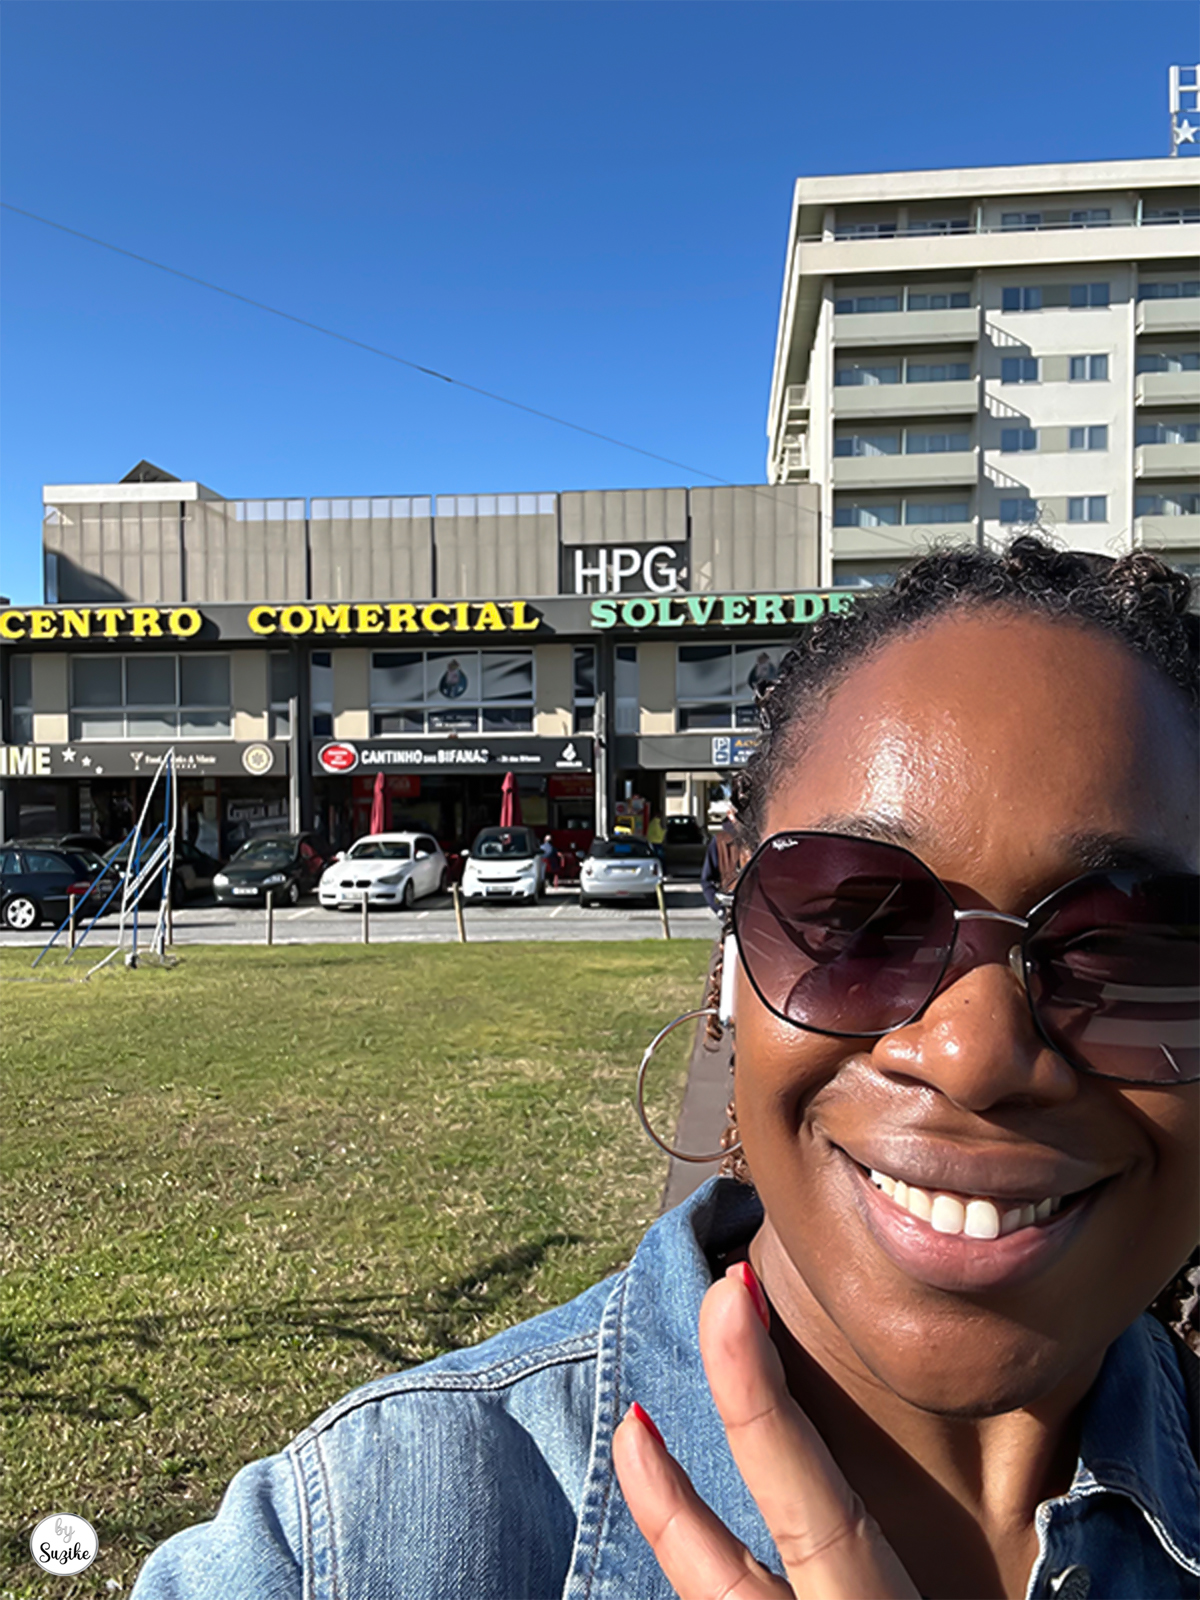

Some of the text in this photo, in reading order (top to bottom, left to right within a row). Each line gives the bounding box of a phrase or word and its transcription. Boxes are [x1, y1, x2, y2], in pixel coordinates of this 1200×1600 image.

[1169, 65, 1200, 113] H
[575, 545, 677, 594] HPG
[0, 592, 855, 639] CENTRO COMERCIAL SOLVERDE
[361, 749, 423, 764] CANTINHO
[438, 749, 489, 763] BIFANAS
